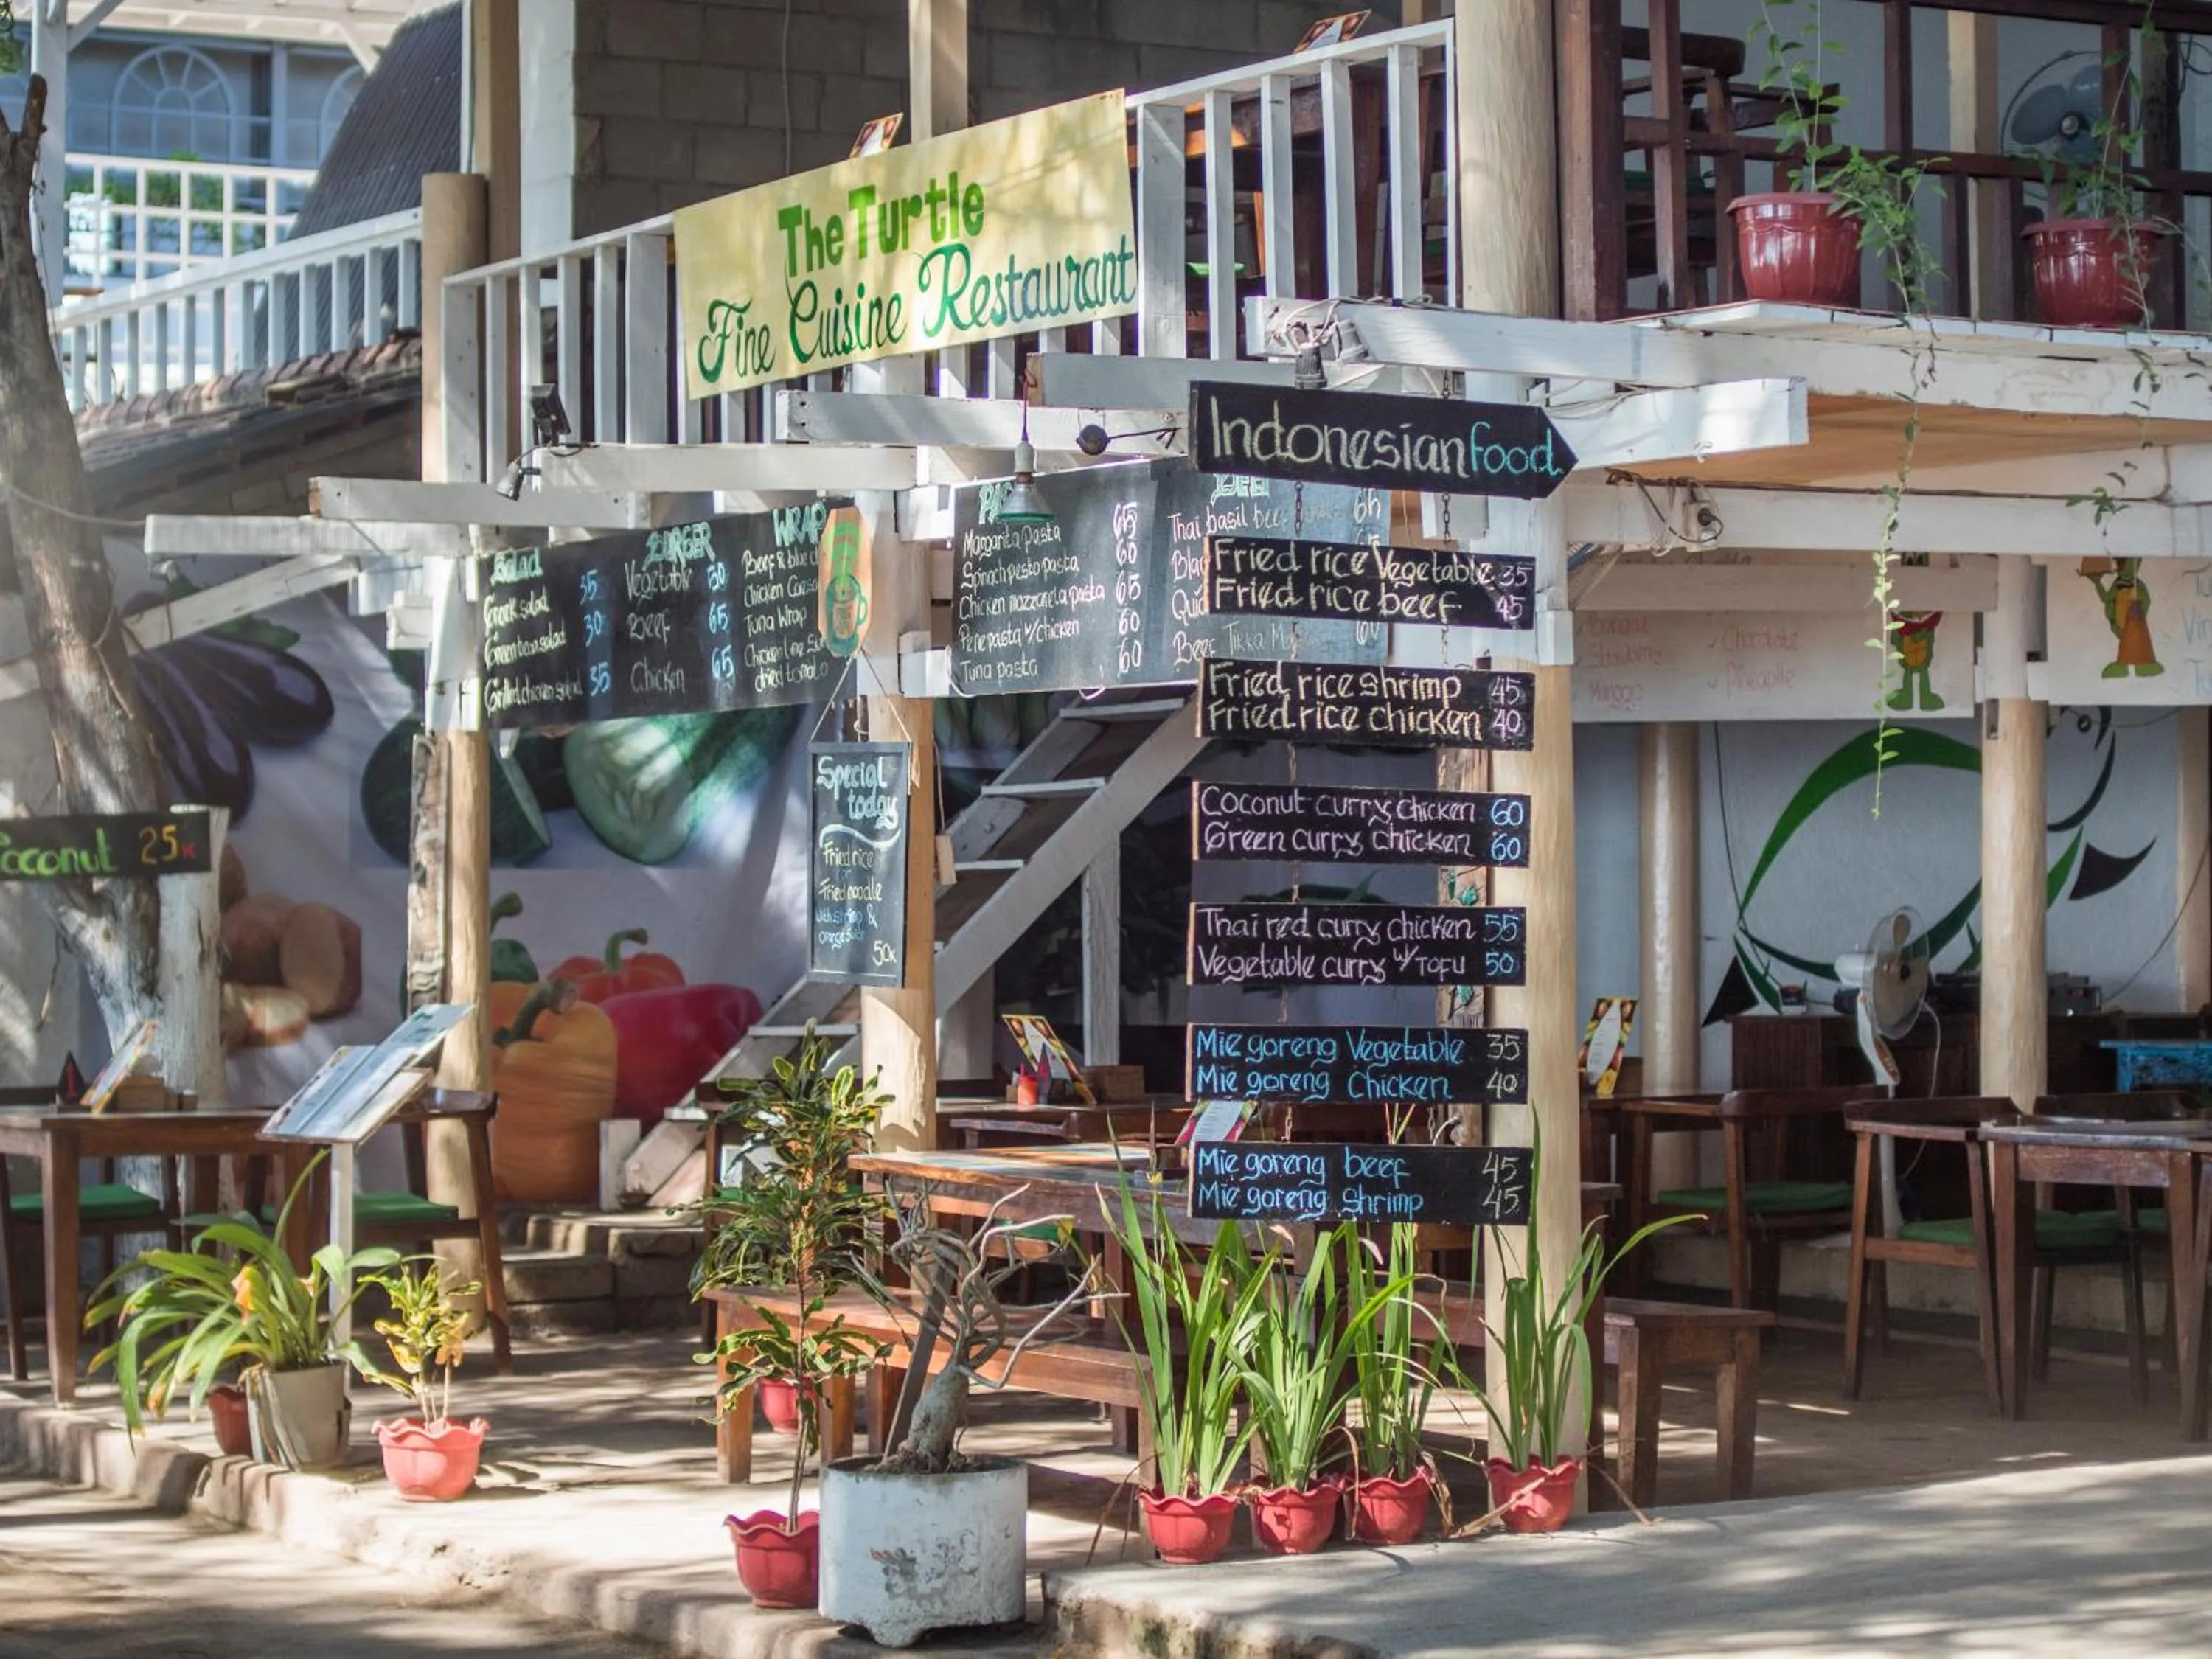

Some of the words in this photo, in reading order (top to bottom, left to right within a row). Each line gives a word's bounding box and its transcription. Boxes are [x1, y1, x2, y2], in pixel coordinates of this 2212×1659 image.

[778, 204, 844, 277] The
[848, 171, 984, 260] Turtle
[698, 296, 776, 383] Fine
[786, 276, 907, 364] Cuisine
[916, 234, 1138, 338] Restaurant
[1211, 396, 1470, 479] Indonesian
[1470, 422, 1565, 475] food
[773, 503, 826, 546] WRAP
[1168, 512, 1200, 543] Thai
[1206, 502, 1248, 535] basil
[1042, 550, 1080, 582] pasta
[1116, 538, 1138, 567] 60
[1215, 538, 1302, 575] Fried
[1310, 546, 1370, 579] rice
[1374, 543, 1494, 587] Vegetable
[1498, 565, 1532, 587] 35
[959, 594, 1006, 620] Chicken
[1116, 570, 1141, 605] 65
[1217, 577, 1303, 609] Fried
[1310, 581, 1371, 612] rice
[1377, 583, 1462, 622] beef
[1496, 595, 1524, 621] 45
[584, 610, 603, 647] 30
[709, 602, 728, 633] 65
[744, 613, 774, 637] Tuna
[1118, 609, 1141, 635] 60
[590, 661, 611, 696] 35
[631, 655, 685, 694] Chicken
[712, 644, 734, 679] 65
[959, 660, 992, 683] Tuna
[998, 650, 1037, 680] pasta
[1119, 637, 1142, 674] 60
[1209, 661, 1290, 700] Fried
[1299, 667, 1354, 699] rice
[1360, 665, 1461, 709] shrimp
[1492, 676, 1522, 705] 45
[1208, 695, 1296, 731] Fried
[1301, 702, 1359, 731] rice
[1369, 702, 1481, 740] chicken
[1492, 709, 1522, 737] 40
[816, 756, 888, 801] Special
[848, 788, 899, 830] today
[1201, 786, 1310, 817] Coconut
[1316, 796, 1391, 827] curry
[1491, 799, 1524, 827] 60
[1205, 821, 1286, 852] Green
[1491, 836, 1521, 861] 60
[1197, 907, 1259, 937] Thai
[1266, 908, 1310, 940] red
[1318, 919, 1381, 951] curry
[1484, 914, 1520, 943] 55
[1198, 943, 1315, 984] Vegetable
[1486, 953, 1514, 975] 50
[1197, 1028, 1242, 1058] Mie
[1247, 1034, 1337, 1068] goreng
[1346, 1029, 1465, 1066] Vegetable
[1487, 1034, 1521, 1060] 35
[1197, 1066, 1239, 1093] Mie
[1245, 1071, 1328, 1102] goreng
[1486, 1071, 1518, 1099] 40
[1198, 1147, 1239, 1176] Mie
[1241, 1153, 1326, 1186] goreng
[1344, 1146, 1411, 1189] beef
[1482, 1151, 1520, 1183] 45
[1198, 1183, 1241, 1209] Mie
[1242, 1187, 1327, 1220] goreng
[1483, 1185, 1524, 1220] 45
